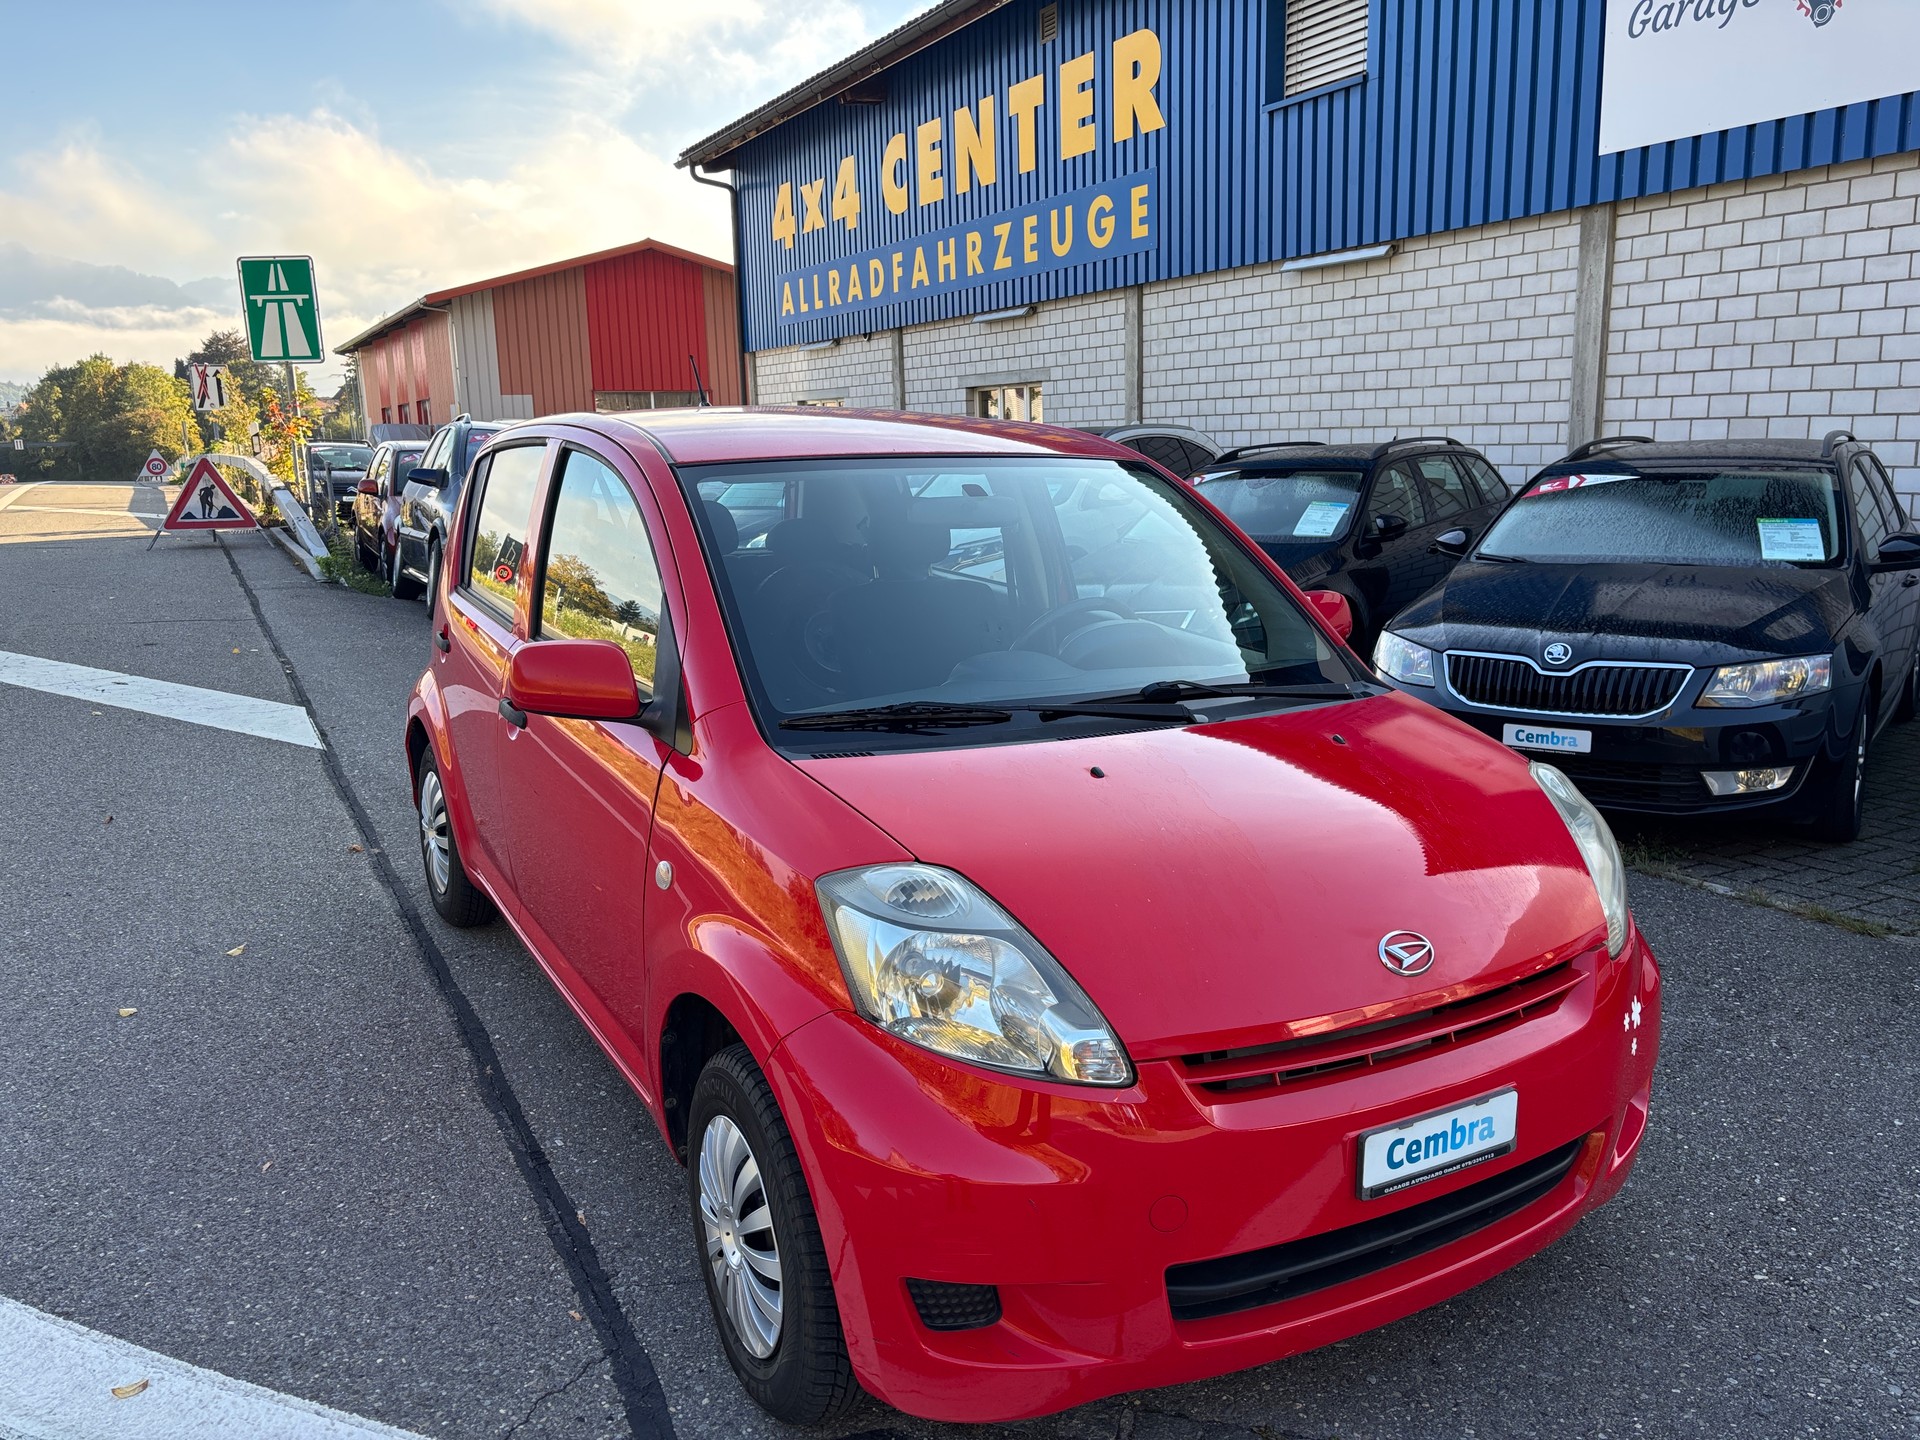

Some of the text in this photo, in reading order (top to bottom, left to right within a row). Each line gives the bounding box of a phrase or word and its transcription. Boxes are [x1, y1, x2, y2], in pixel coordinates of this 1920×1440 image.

[772, 28, 1166, 249] 4x4 CENTER
[781, 184, 1149, 317] ALLRADFAHRZEUGE
[1515, 729, 1578, 747] Cembra
[1386, 1116, 1495, 1170] Cembra
[1384, 1181, 1410, 1193] GARAGE
